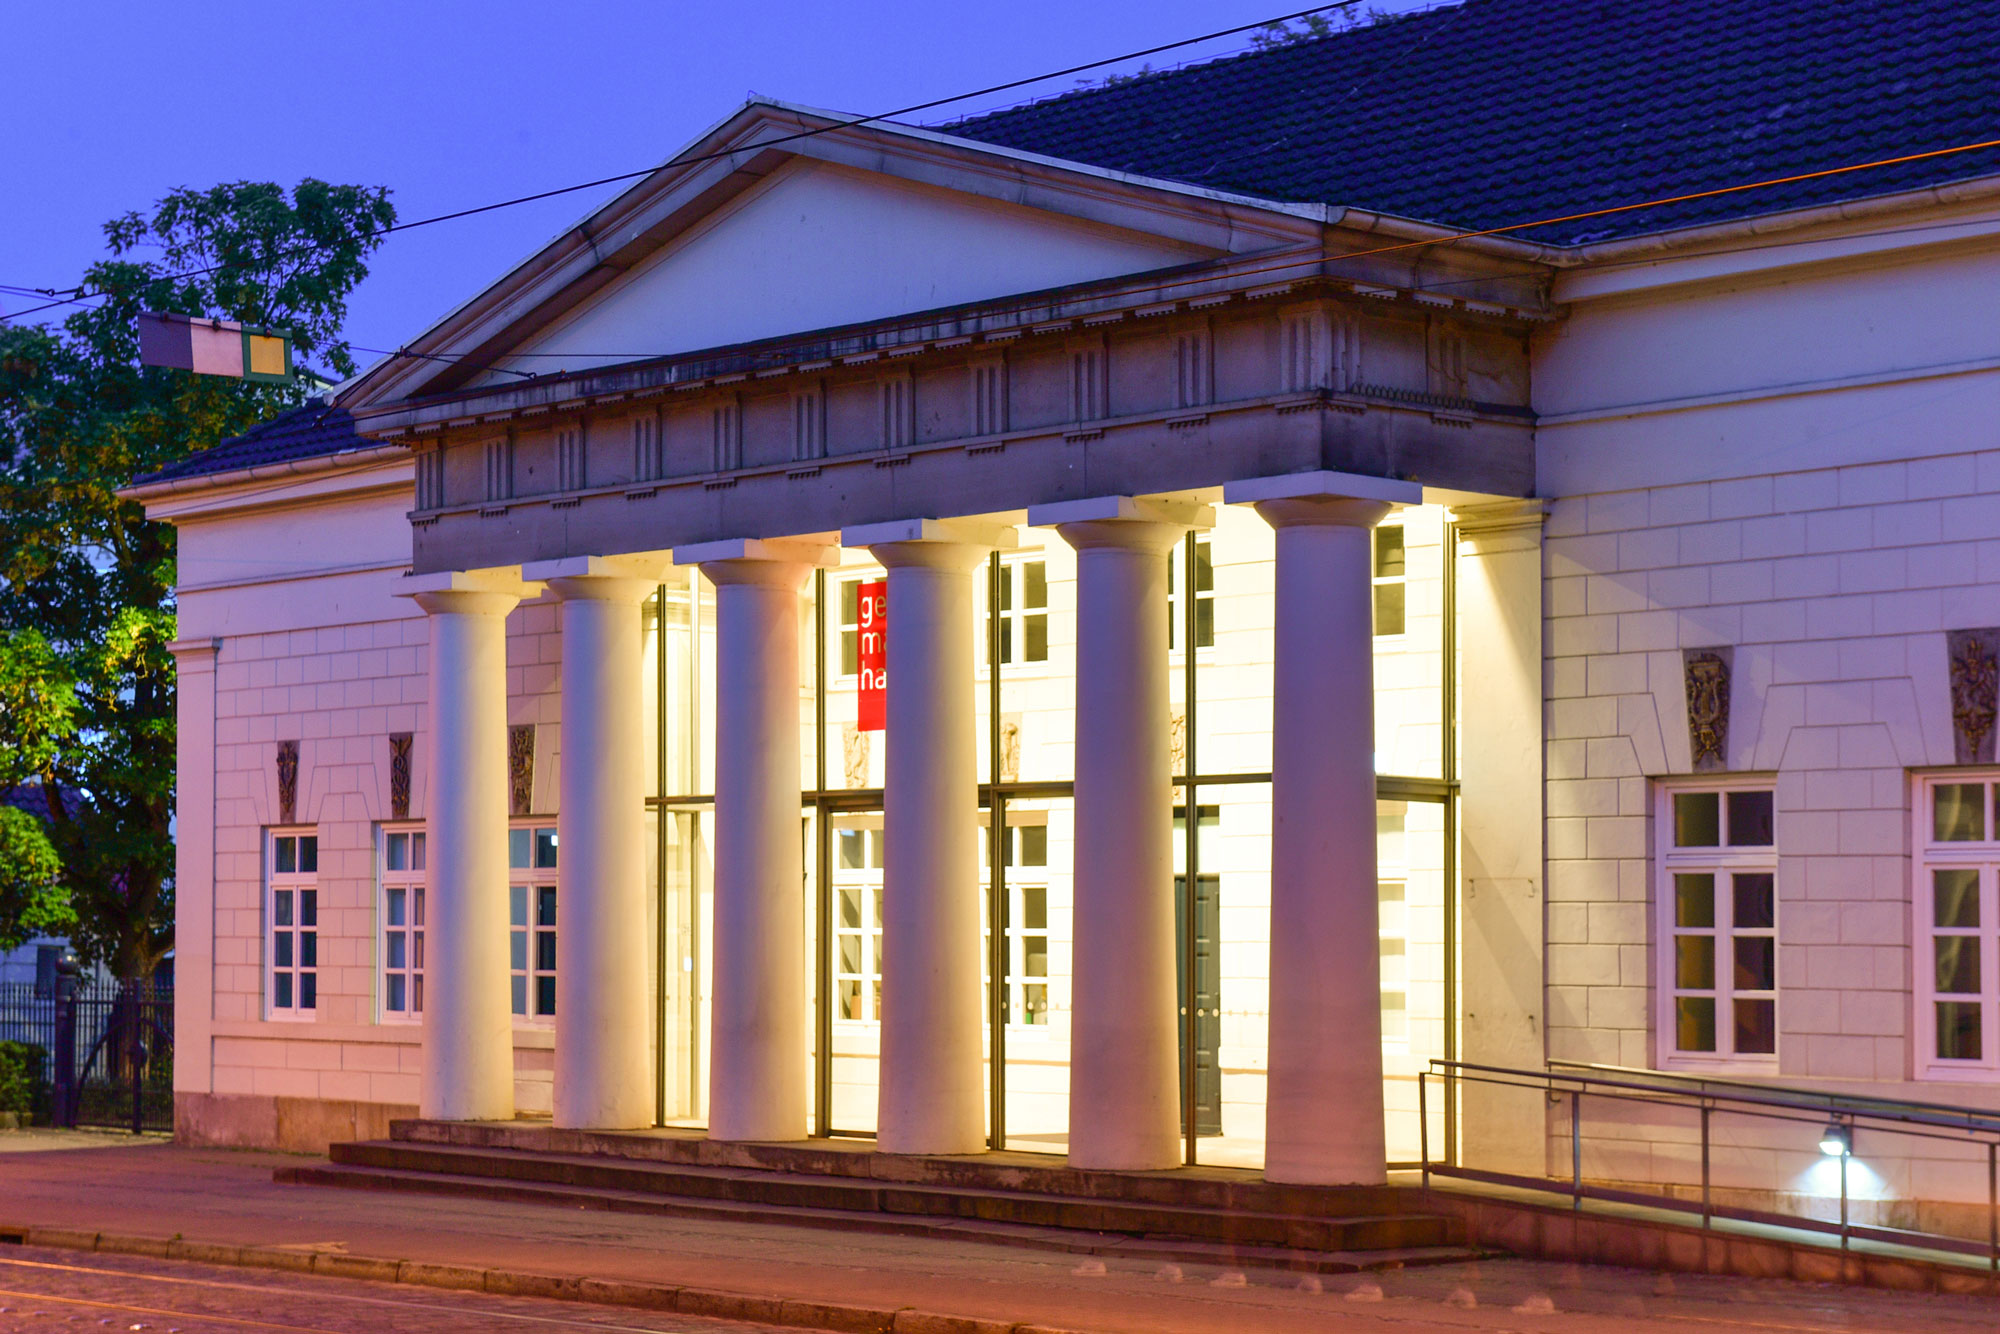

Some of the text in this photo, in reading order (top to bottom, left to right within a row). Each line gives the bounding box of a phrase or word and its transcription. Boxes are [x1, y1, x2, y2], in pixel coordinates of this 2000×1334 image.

[861, 595, 886, 628] ge
[862, 632, 886, 654] m
[861, 660, 886, 690] ha
